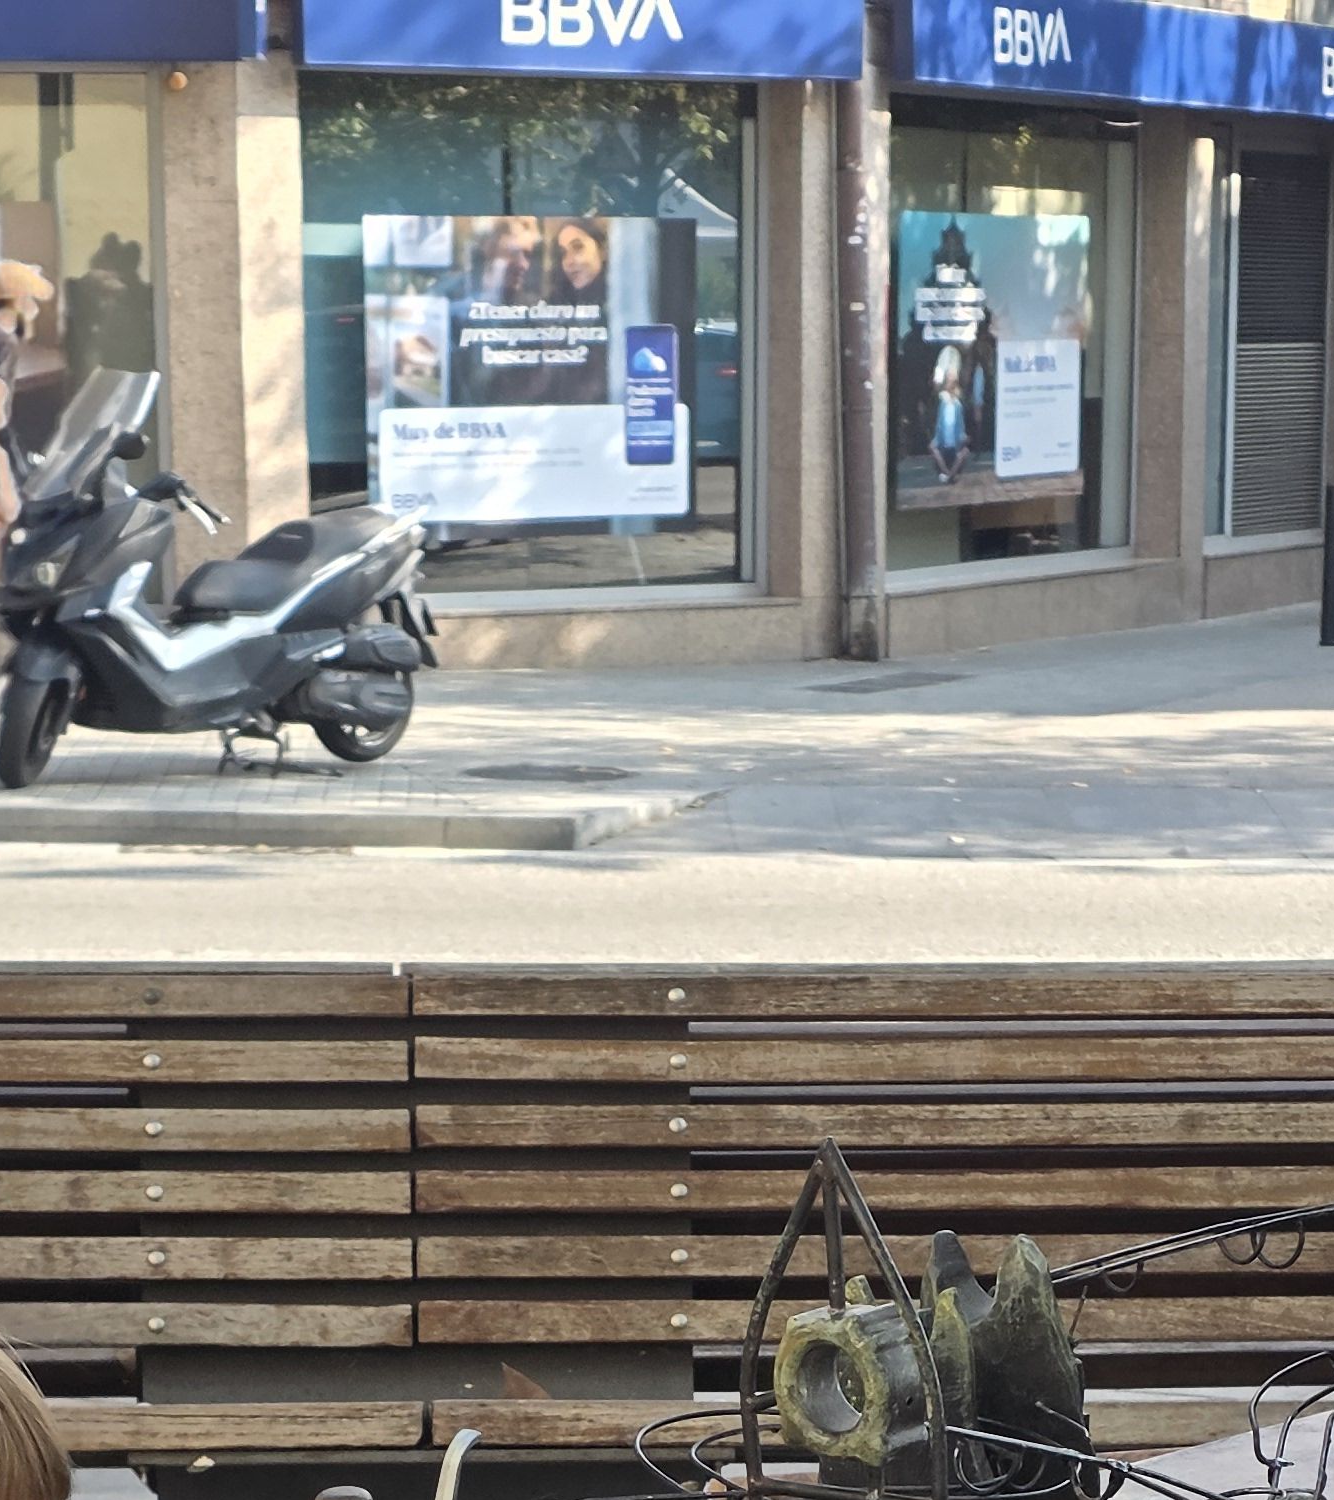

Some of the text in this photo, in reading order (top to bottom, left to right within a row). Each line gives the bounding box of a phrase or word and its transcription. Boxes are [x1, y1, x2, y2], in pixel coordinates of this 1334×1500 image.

[500, 0, 684, 47] BBVA
[993, 6, 1072, 67] BBVA
[468, 299, 601, 320] ¿Tener claro un
[459, 327, 608, 347] presupuesto para
[481, 345, 589, 364] buscar casa?
[392, 422, 507, 442] Muy de BBVA
[391, 492, 438, 510] BBVA
